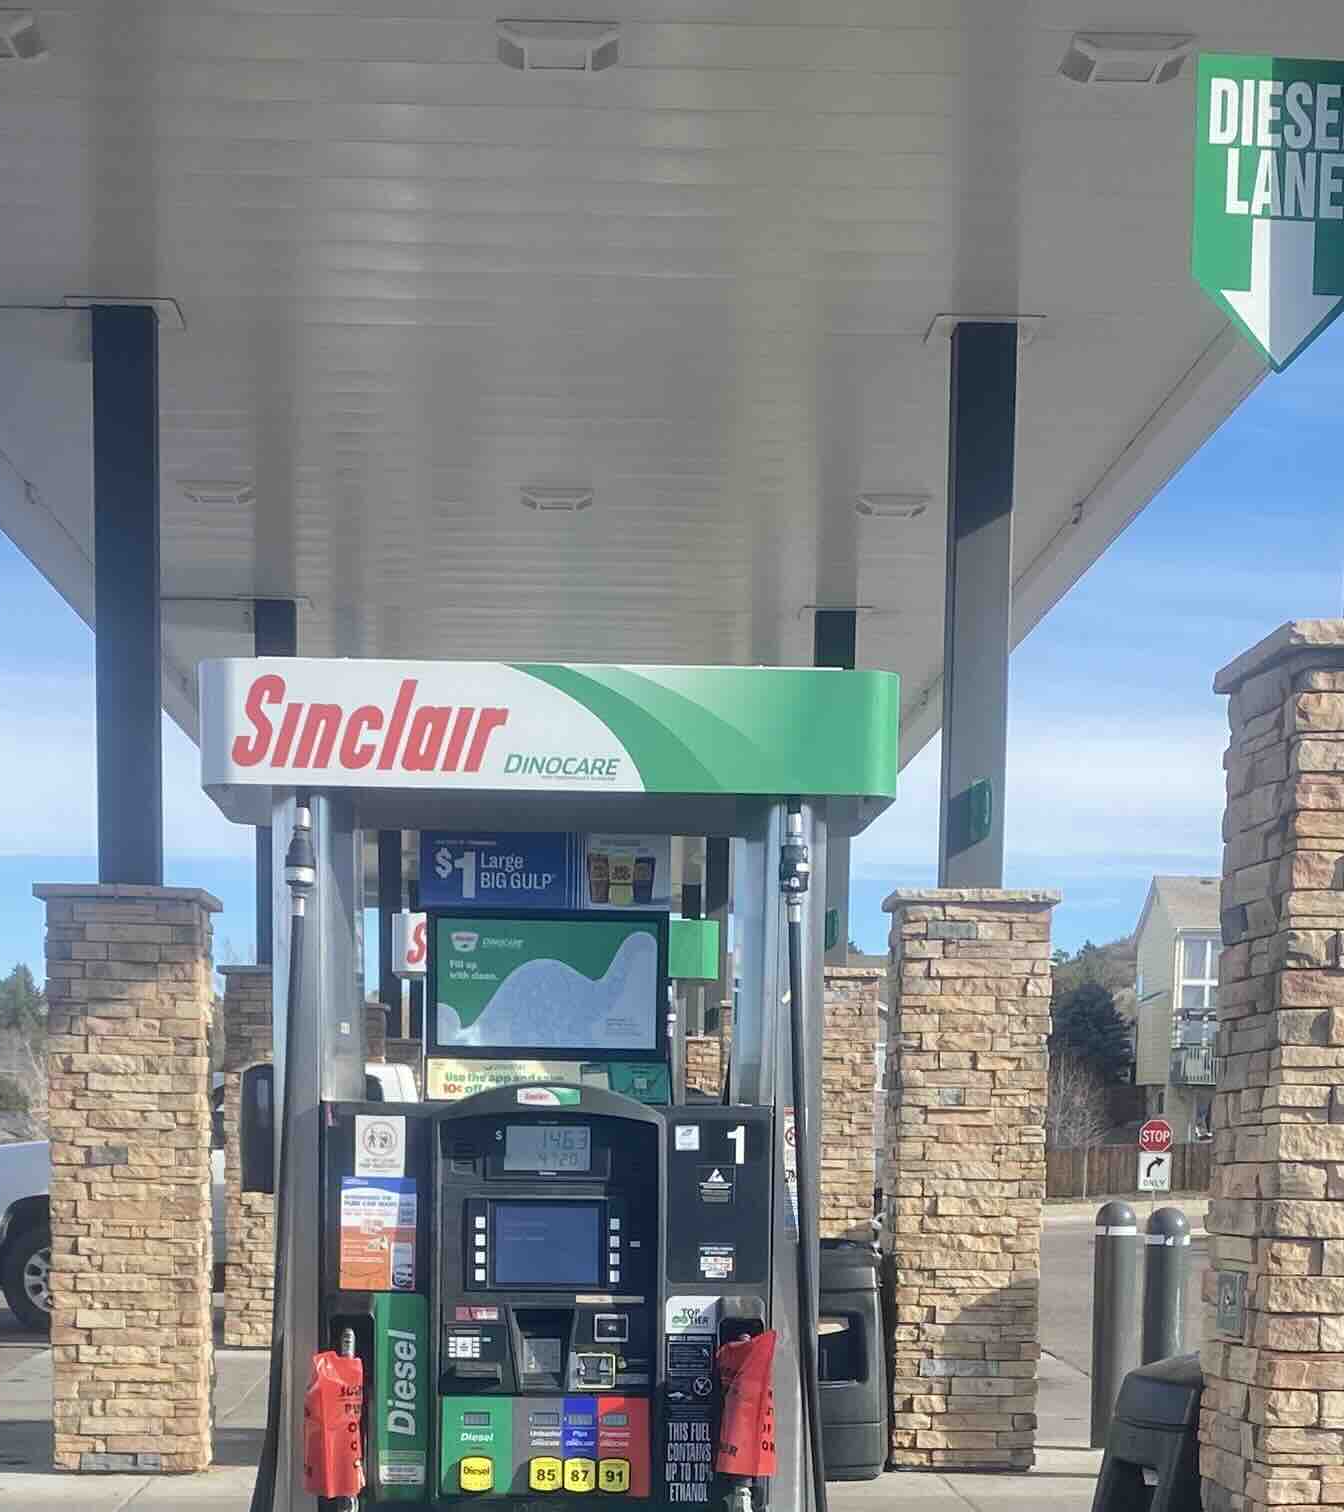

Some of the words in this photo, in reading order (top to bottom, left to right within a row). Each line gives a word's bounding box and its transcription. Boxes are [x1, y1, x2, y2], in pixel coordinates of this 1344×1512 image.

[231, 673, 512, 773] Sinclair
[503, 753, 622, 778] DINOCARE
[434, 846, 477, 899] $1
[480, 852, 524, 873] Large
[480, 872, 507, 889] BIG
[448, 958, 464, 970] Fill
[445, 1071, 464, 1082] Use
[466, 1071, 486, 1082] the
[488, 1072, 511, 1085] app
[512, 1071, 536, 1082] and
[1142, 1129, 1170, 1143] STOP
[726, 1124, 746, 1165] 1
[1142, 1178, 1167, 1188] ONLY
[680, 1307, 701, 1319] TOP
[387, 1328, 417, 1436] Diesel
[460, 1431, 494, 1443] Diesel
[667, 1422, 688, 1442] THIS
[691, 1422, 712, 1442] FUEL
[667, 1442, 712, 1462] CONTAINS
[462, 1465, 491, 1476] Diesel
[536, 1467, 556, 1482] 85
[570, 1468, 590, 1482] 87
[605, 1468, 625, 1484] 91
[665, 1462, 678, 1482] UP
[680, 1462, 692, 1482] TO
[669, 1482, 708, 1503] ETHANOL
